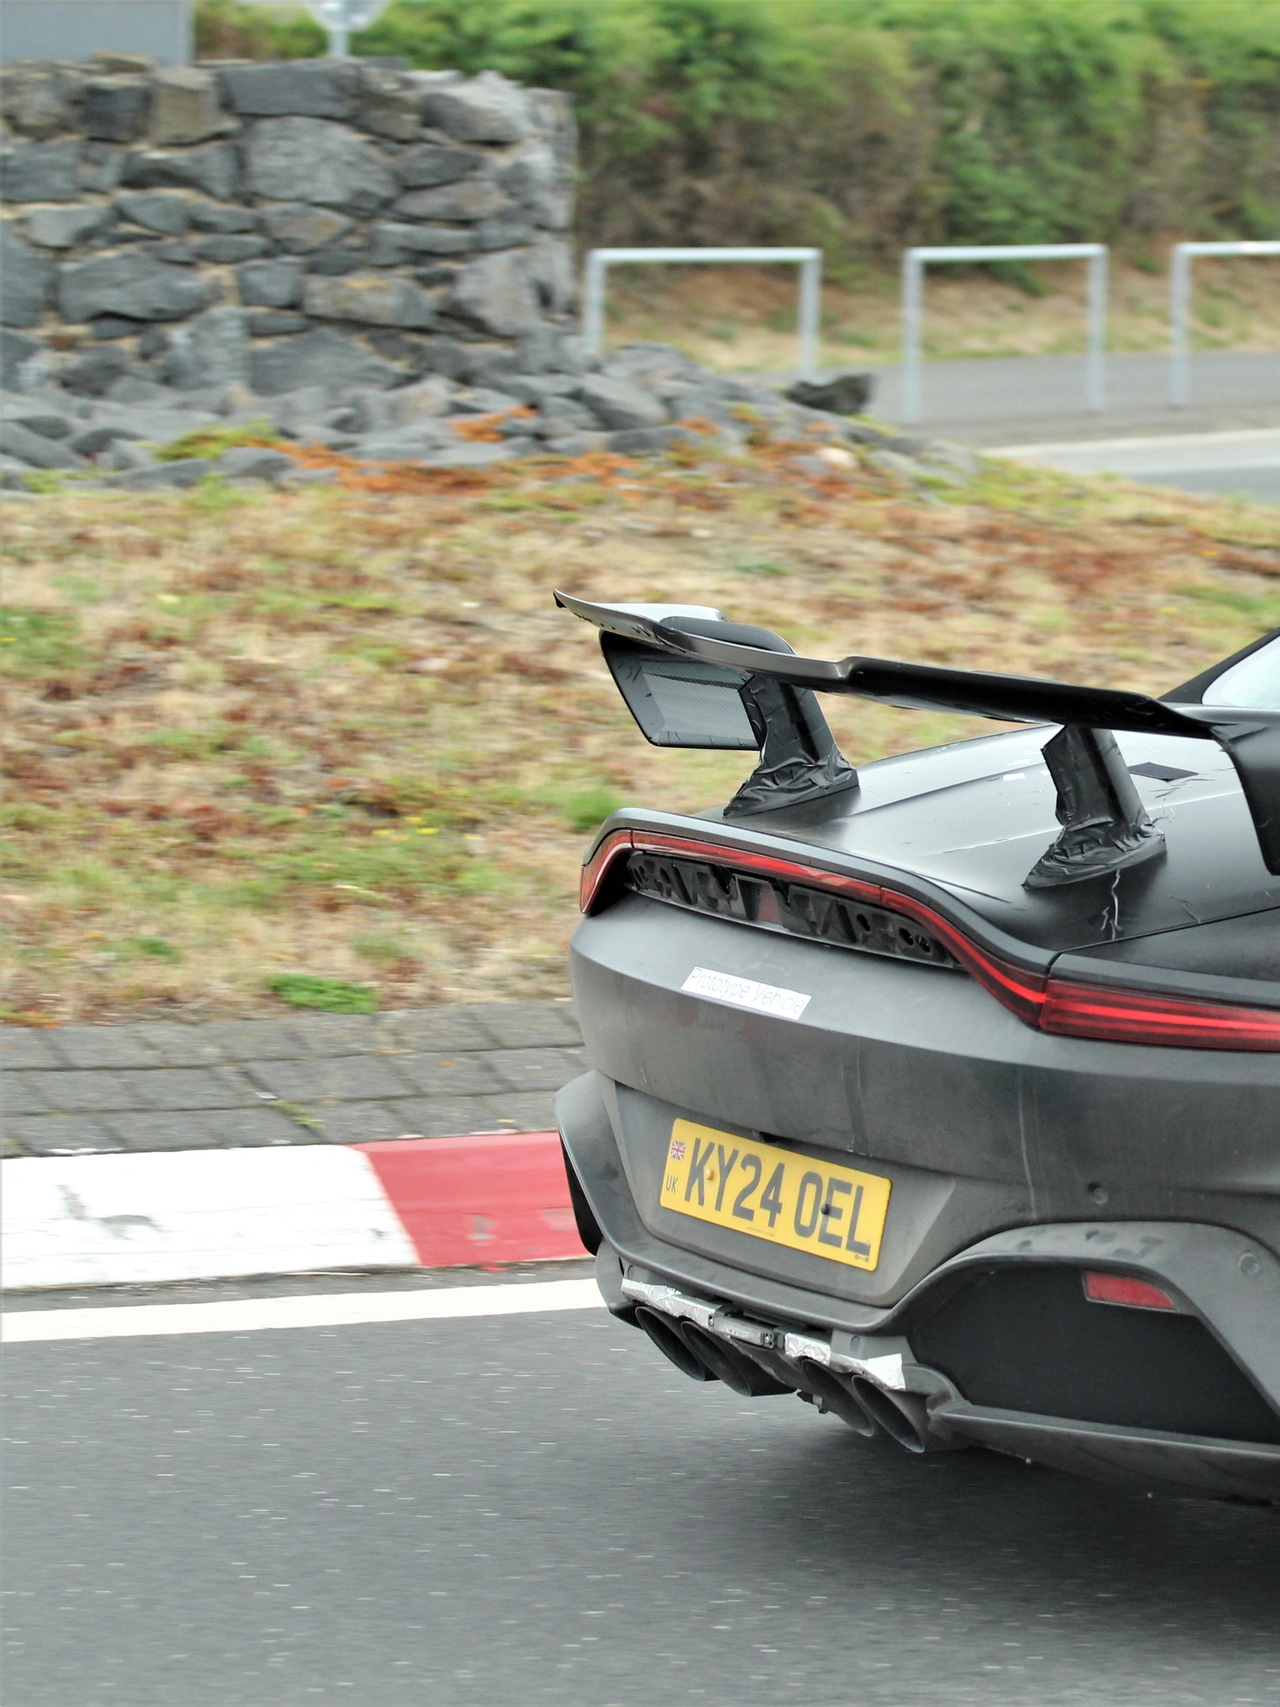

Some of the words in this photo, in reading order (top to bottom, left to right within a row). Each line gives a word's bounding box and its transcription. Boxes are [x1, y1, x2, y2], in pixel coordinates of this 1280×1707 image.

[688, 968, 750, 998] Prototype
[753, 984, 805, 1014] Vehicle
[665, 1174, 679, 1194] UK
[684, 1137, 786, 1229] KY24
[794, 1171, 871, 1257] OEL
